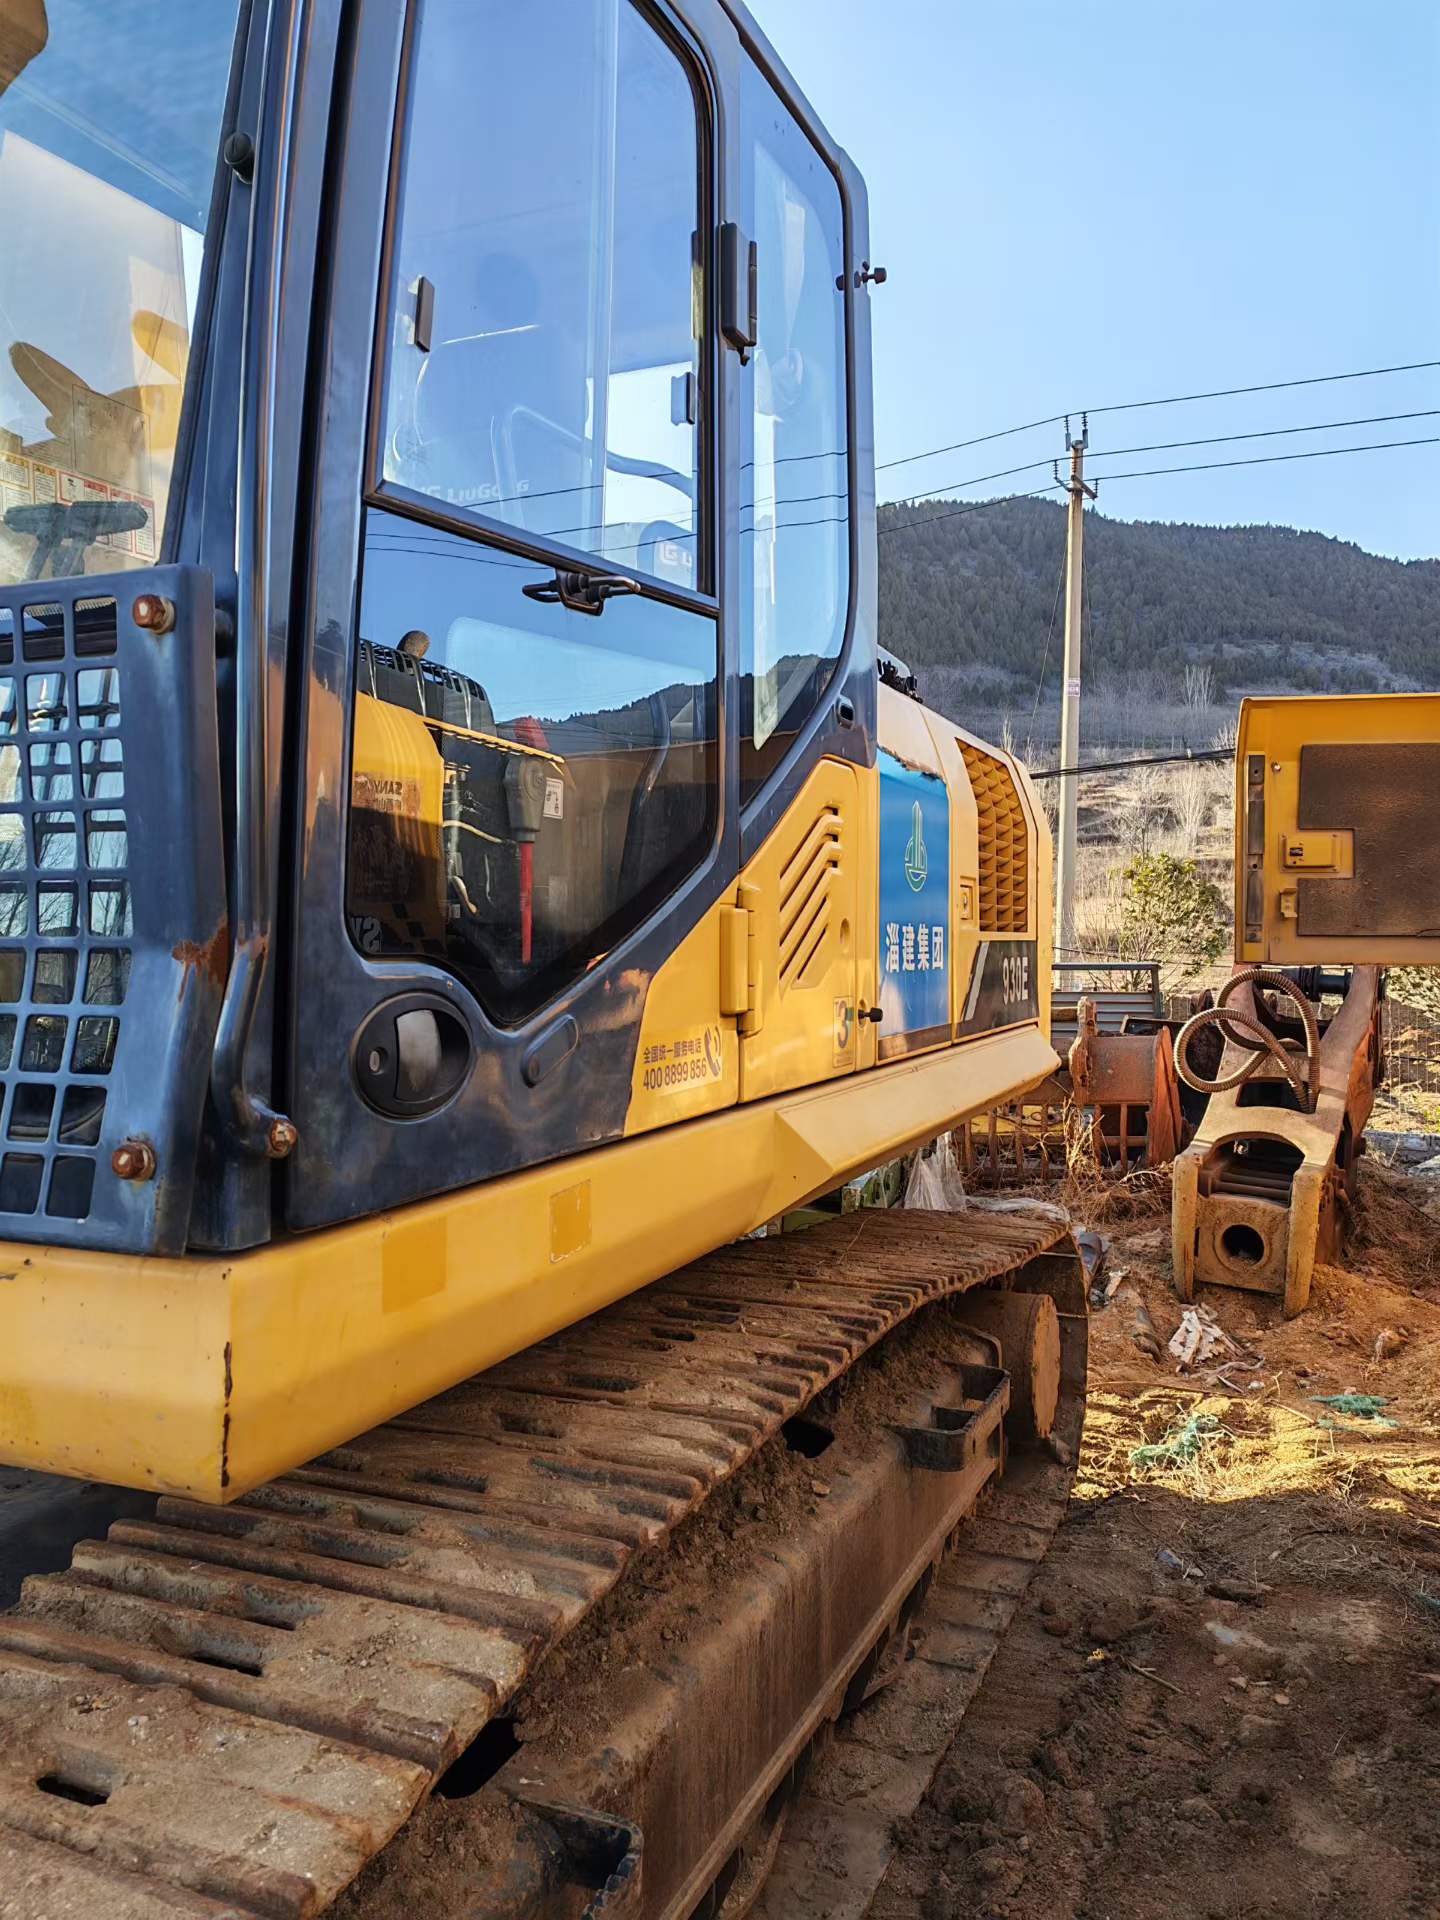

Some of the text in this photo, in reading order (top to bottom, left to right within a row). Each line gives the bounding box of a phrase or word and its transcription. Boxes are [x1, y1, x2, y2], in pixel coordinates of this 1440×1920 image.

[885, 922, 944, 973] 淄建集团
[1002, 956, 1029, 1006] 930E
[643, 1038, 702, 1064] 全国统一服务电话
[643, 1057, 707, 1091] 400 8899 856
